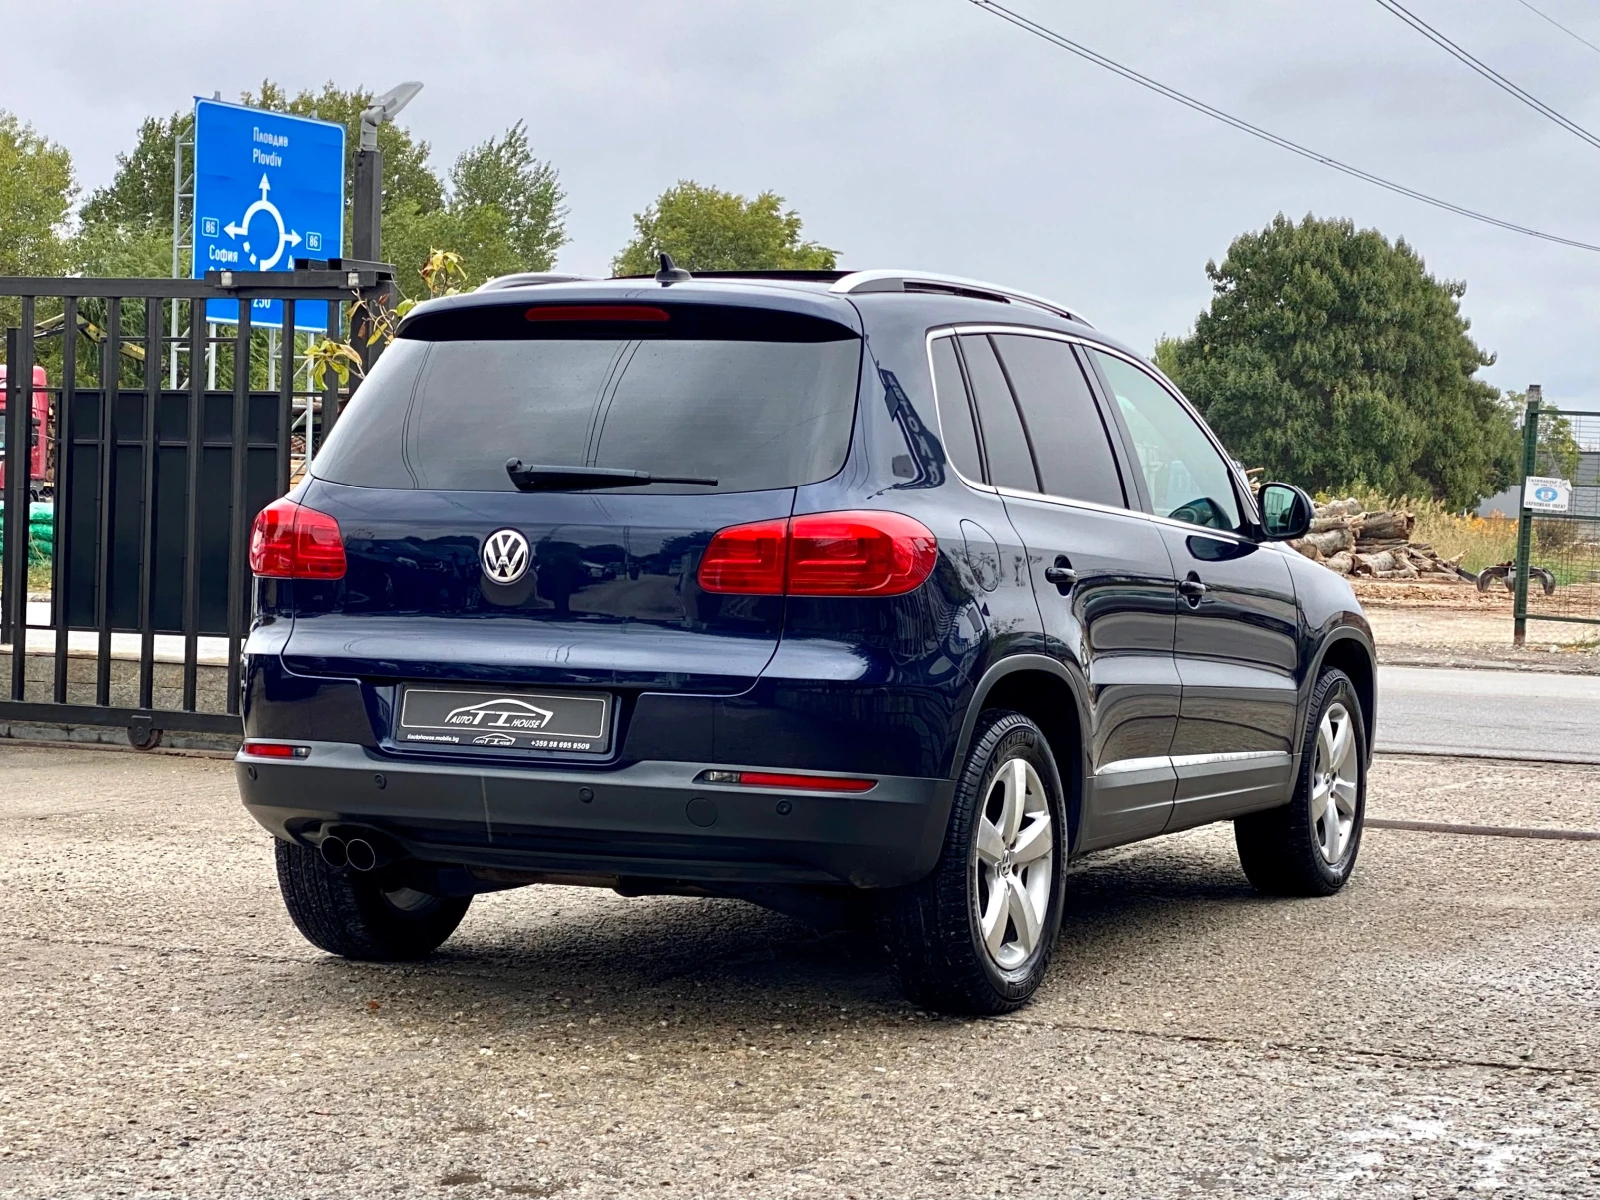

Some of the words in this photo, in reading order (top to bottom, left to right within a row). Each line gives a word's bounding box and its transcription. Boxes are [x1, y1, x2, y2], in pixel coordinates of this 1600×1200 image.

[253, 126, 289, 148] Пловдив
[253, 148, 282, 167] Plovdiv
[205, 220, 216, 234] 86
[309, 235, 319, 248] 86
[209, 244, 239, 263] София
[450, 715, 473, 724] AUTO
[511, 718, 541, 728] HOUSE
[531, 740, 547, 748] +359
[558, 741, 572, 749] 695
[572, 742, 590, 750] 9509
